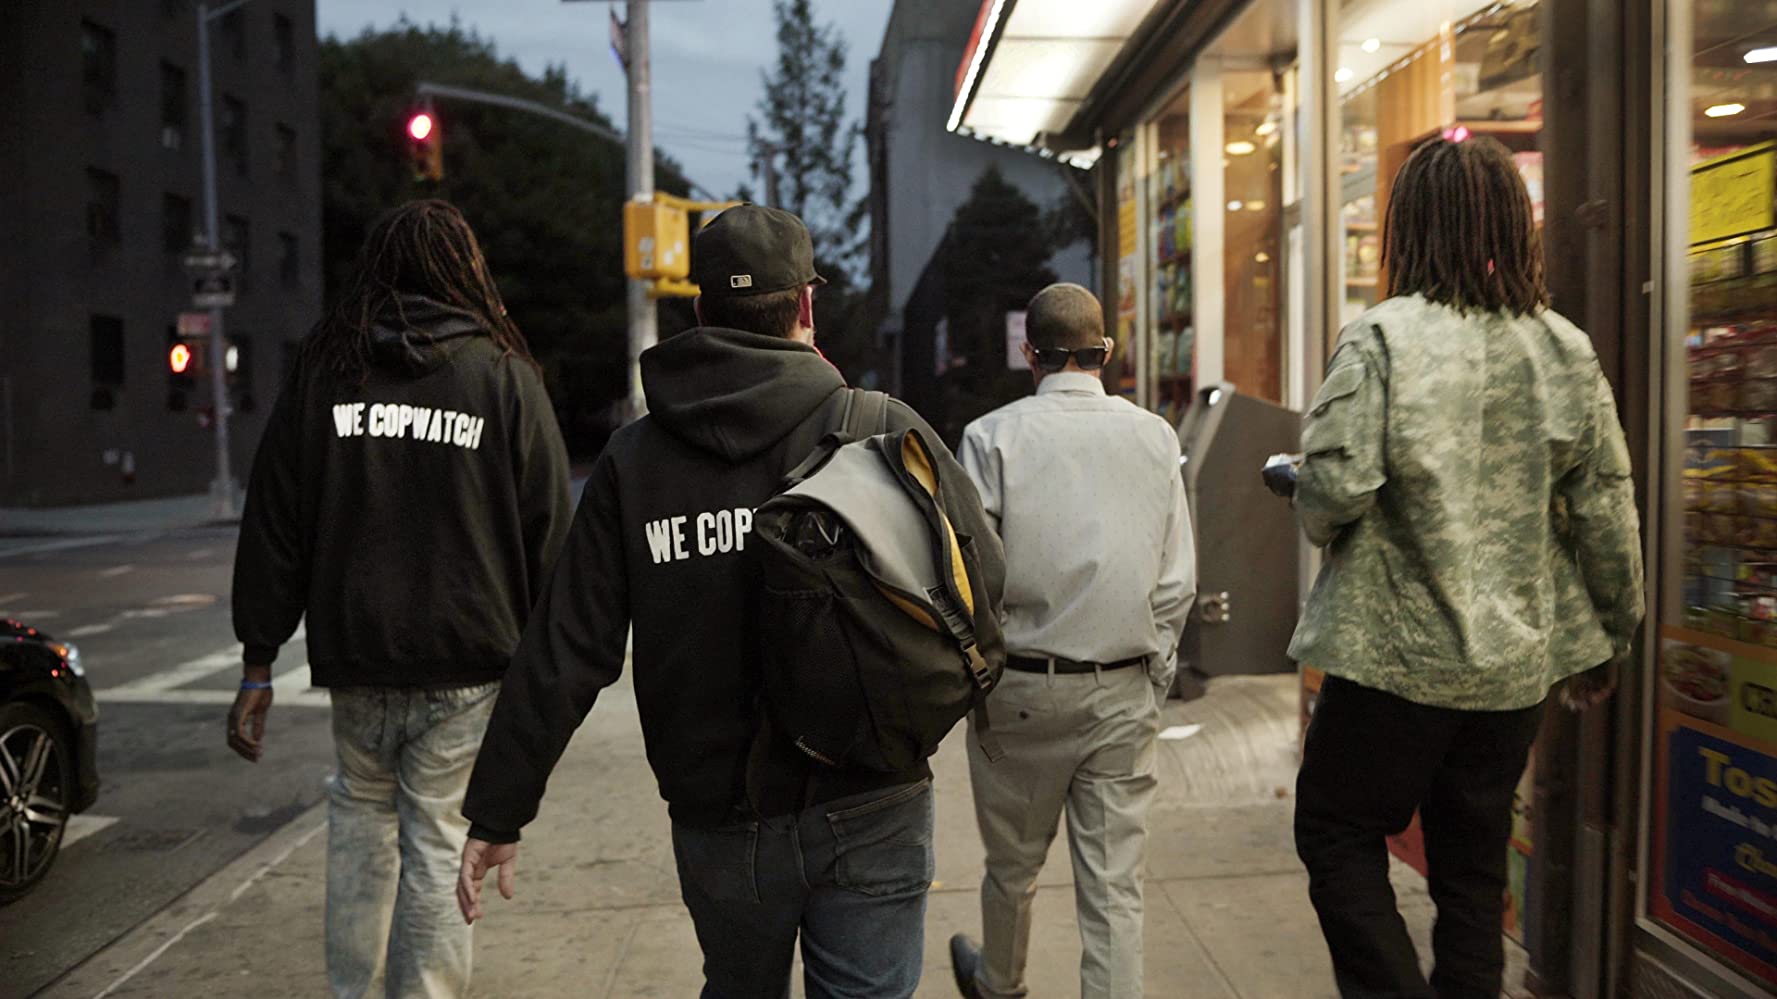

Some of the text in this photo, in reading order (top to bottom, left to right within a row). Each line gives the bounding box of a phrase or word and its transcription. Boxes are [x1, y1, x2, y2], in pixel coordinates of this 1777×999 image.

[333, 402, 485, 450] WE COPWATCH
[645, 507, 757, 564] WE COP
